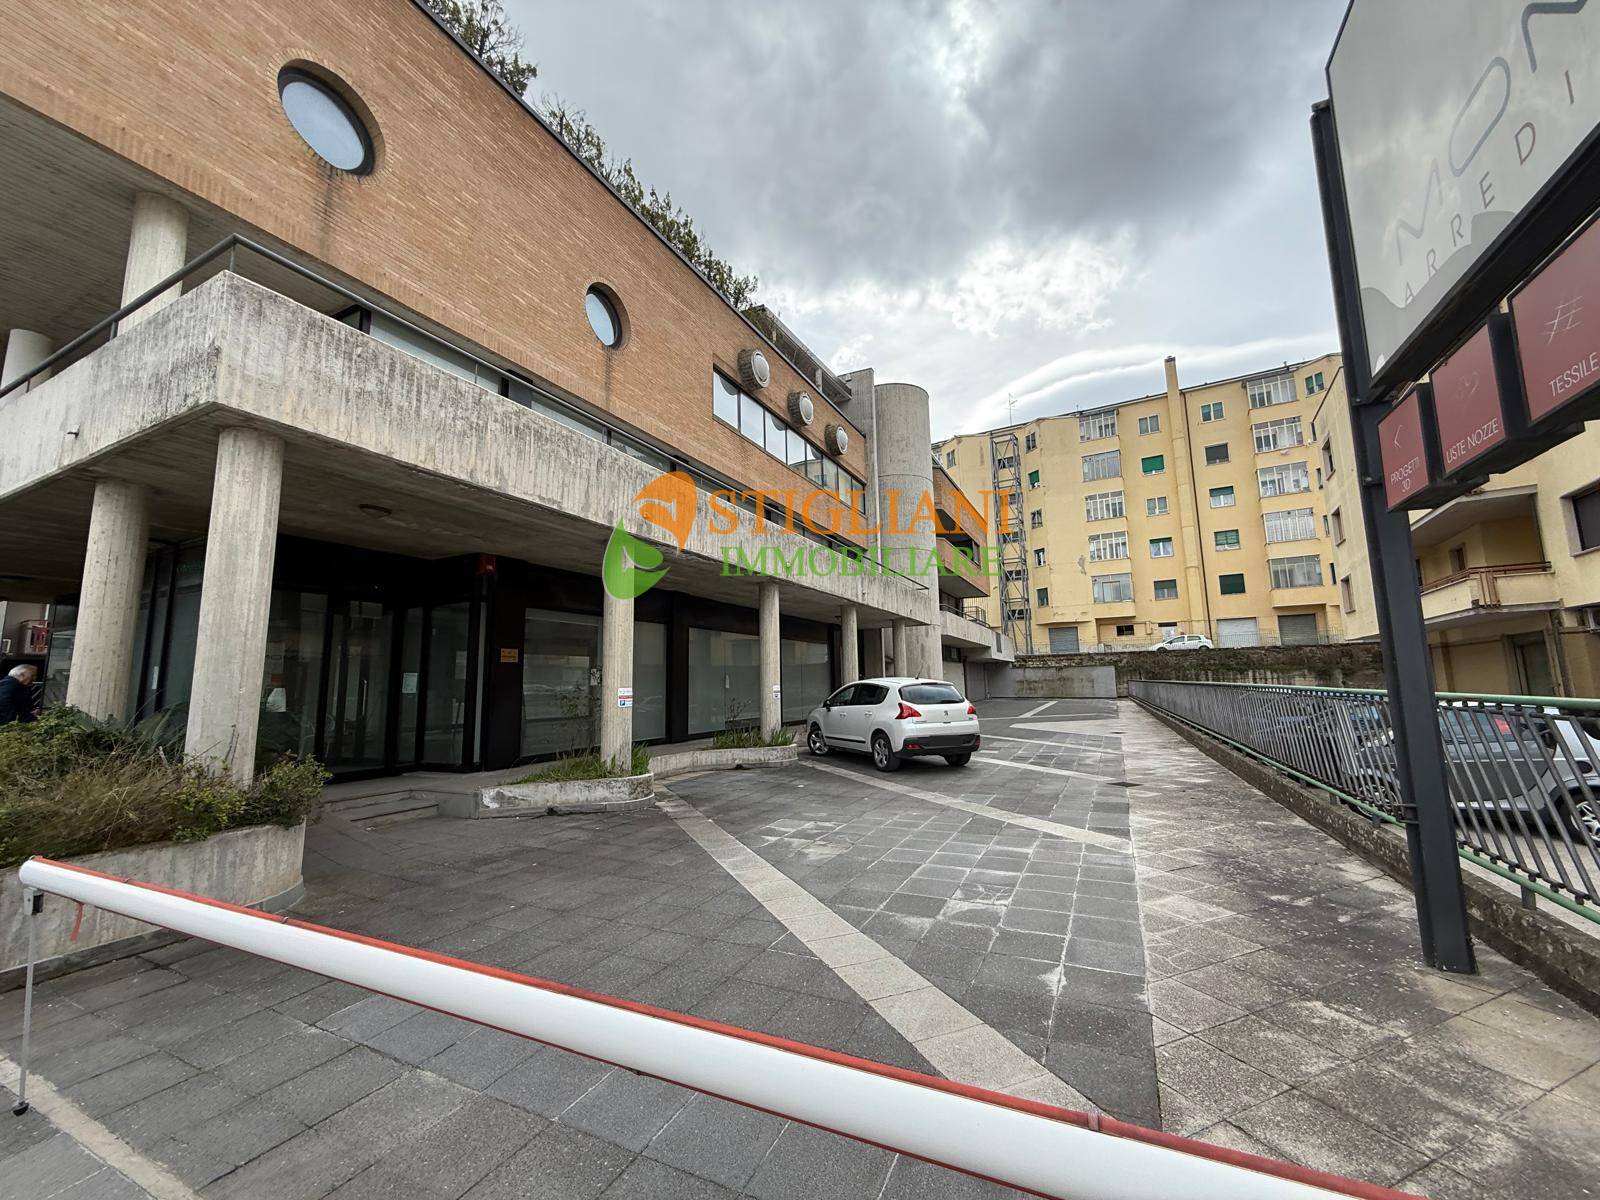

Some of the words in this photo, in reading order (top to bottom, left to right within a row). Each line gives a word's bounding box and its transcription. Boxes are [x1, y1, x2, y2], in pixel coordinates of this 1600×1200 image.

[1403, 69, 1575, 304] ARREDI
[1548, 351, 1600, 397] TESSILE
[1446, 439, 1466, 464] LISTE
[1467, 418, 1499, 447] NOZZE
[1401, 477, 1411, 492] 3D
